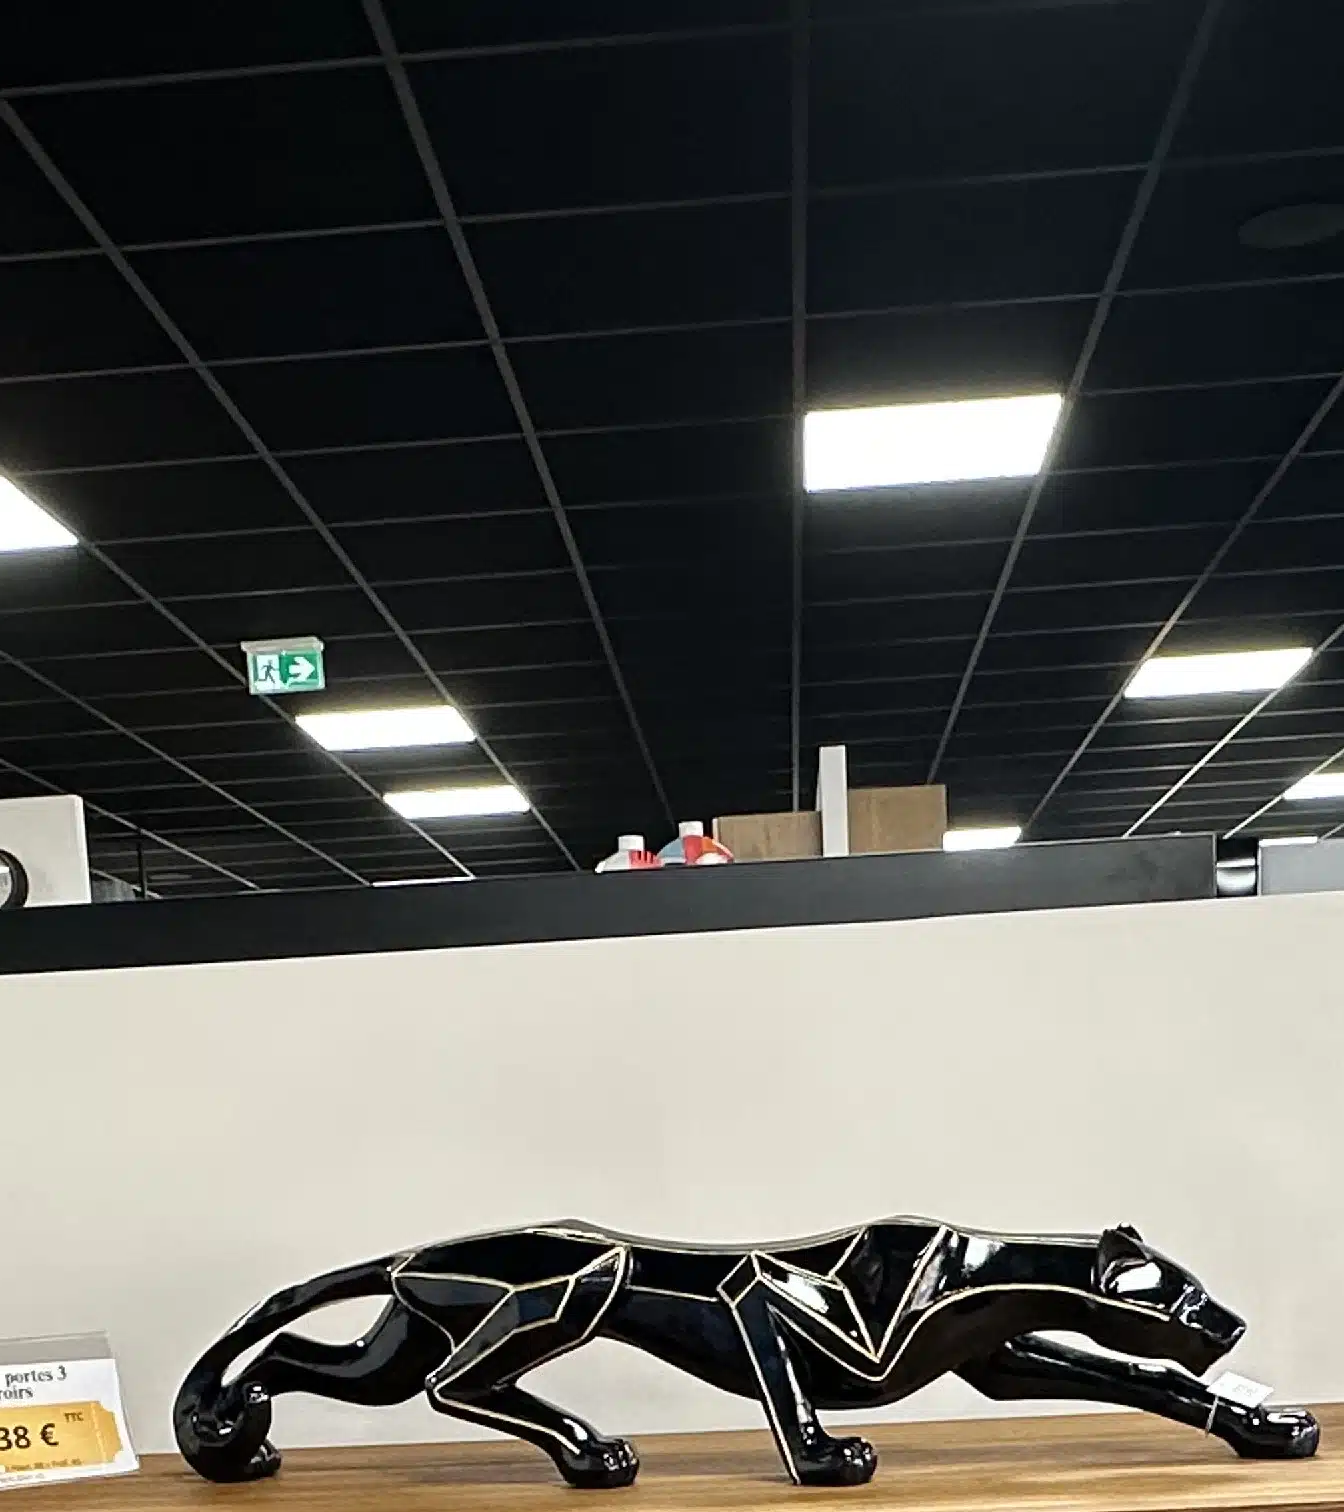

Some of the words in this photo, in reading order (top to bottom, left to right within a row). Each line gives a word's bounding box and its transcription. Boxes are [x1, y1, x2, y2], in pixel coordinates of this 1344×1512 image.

[4, 1370, 53, 1387] portes
[56, 1365, 67, 1381] 3
[40, 1423, 60, 1446] €
[63, 1411, 84, 1423] TTC
